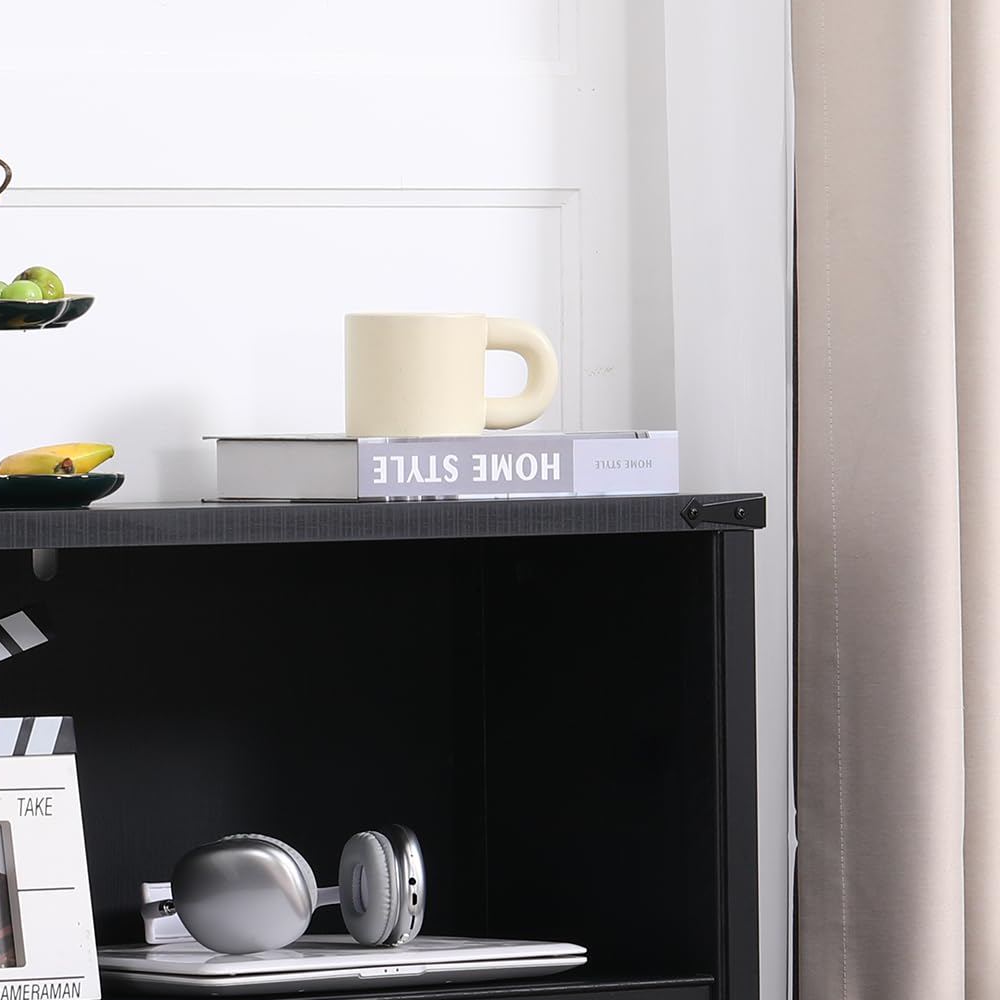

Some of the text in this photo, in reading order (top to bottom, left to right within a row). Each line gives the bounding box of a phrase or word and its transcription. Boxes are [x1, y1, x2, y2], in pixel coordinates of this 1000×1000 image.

[372, 452, 561, 484] HOME STYLE
[594, 459, 652, 470] HOME STYLE
[17, 797, 53, 817] TAKE
